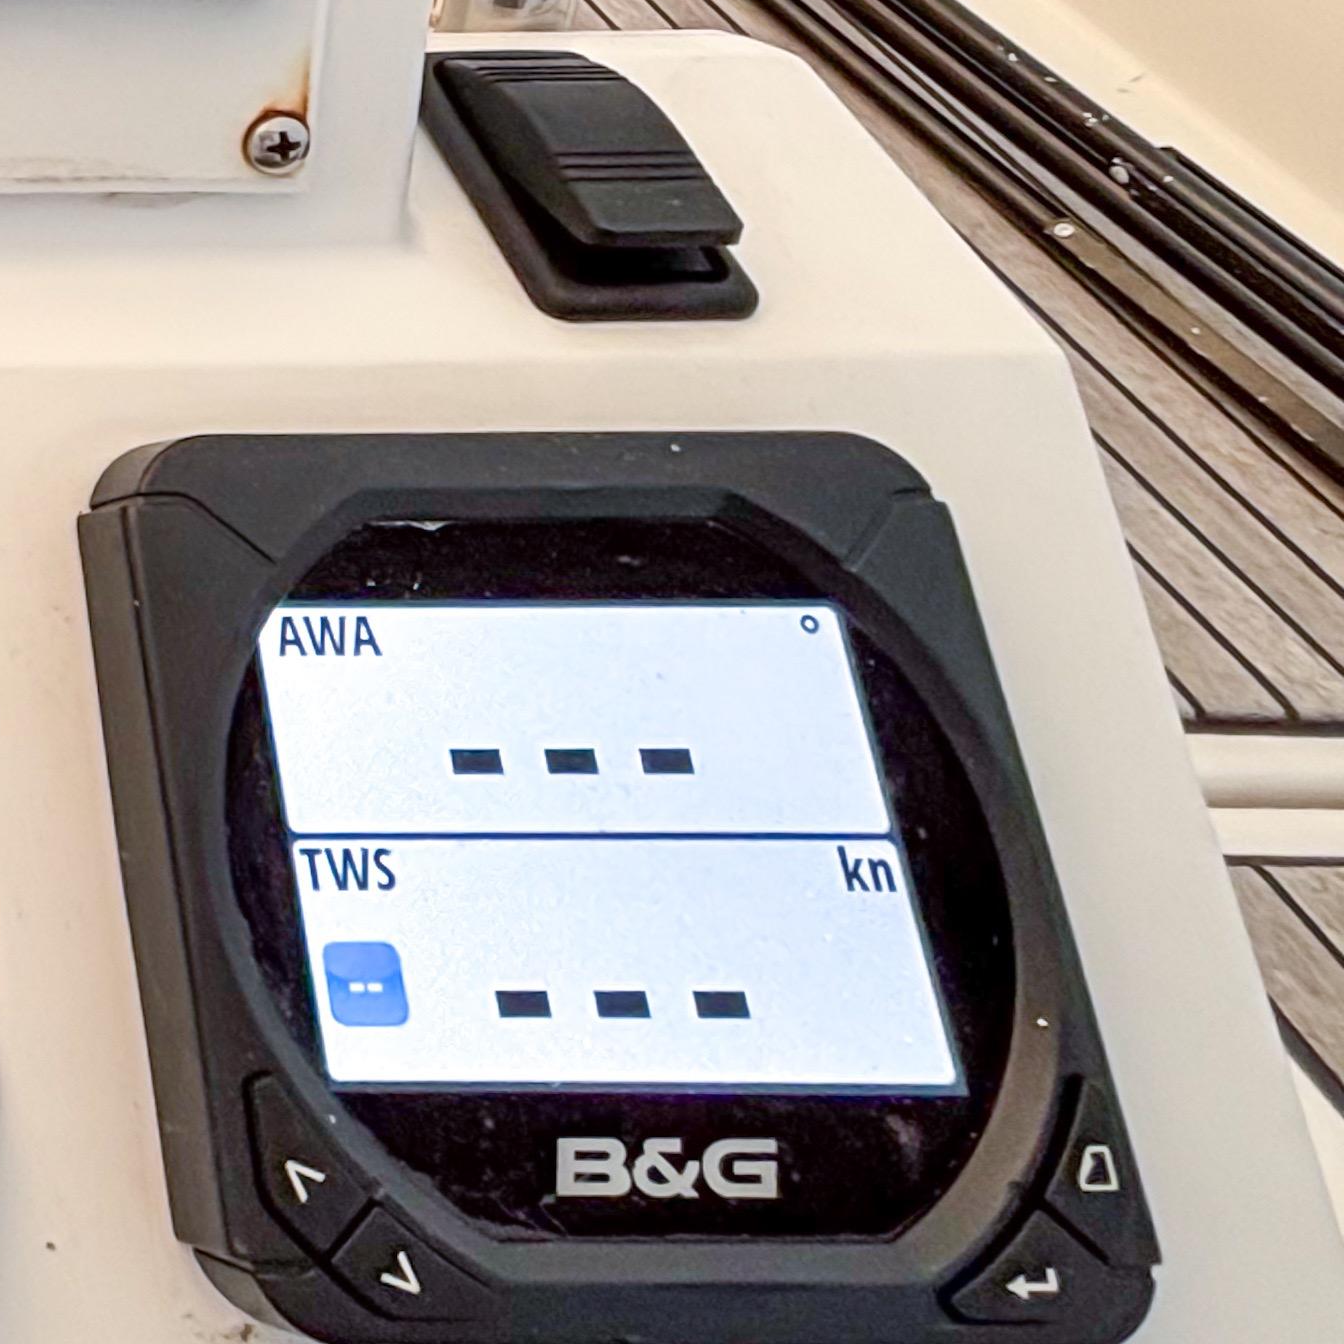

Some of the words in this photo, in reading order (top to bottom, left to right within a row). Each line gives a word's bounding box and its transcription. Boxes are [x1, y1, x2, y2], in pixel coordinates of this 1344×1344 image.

[278, 616, 383, 658] AWA
[300, 847, 397, 893] TWS
[838, 847, 899, 894] kn
[555, 1136, 779, 1199] B&G
